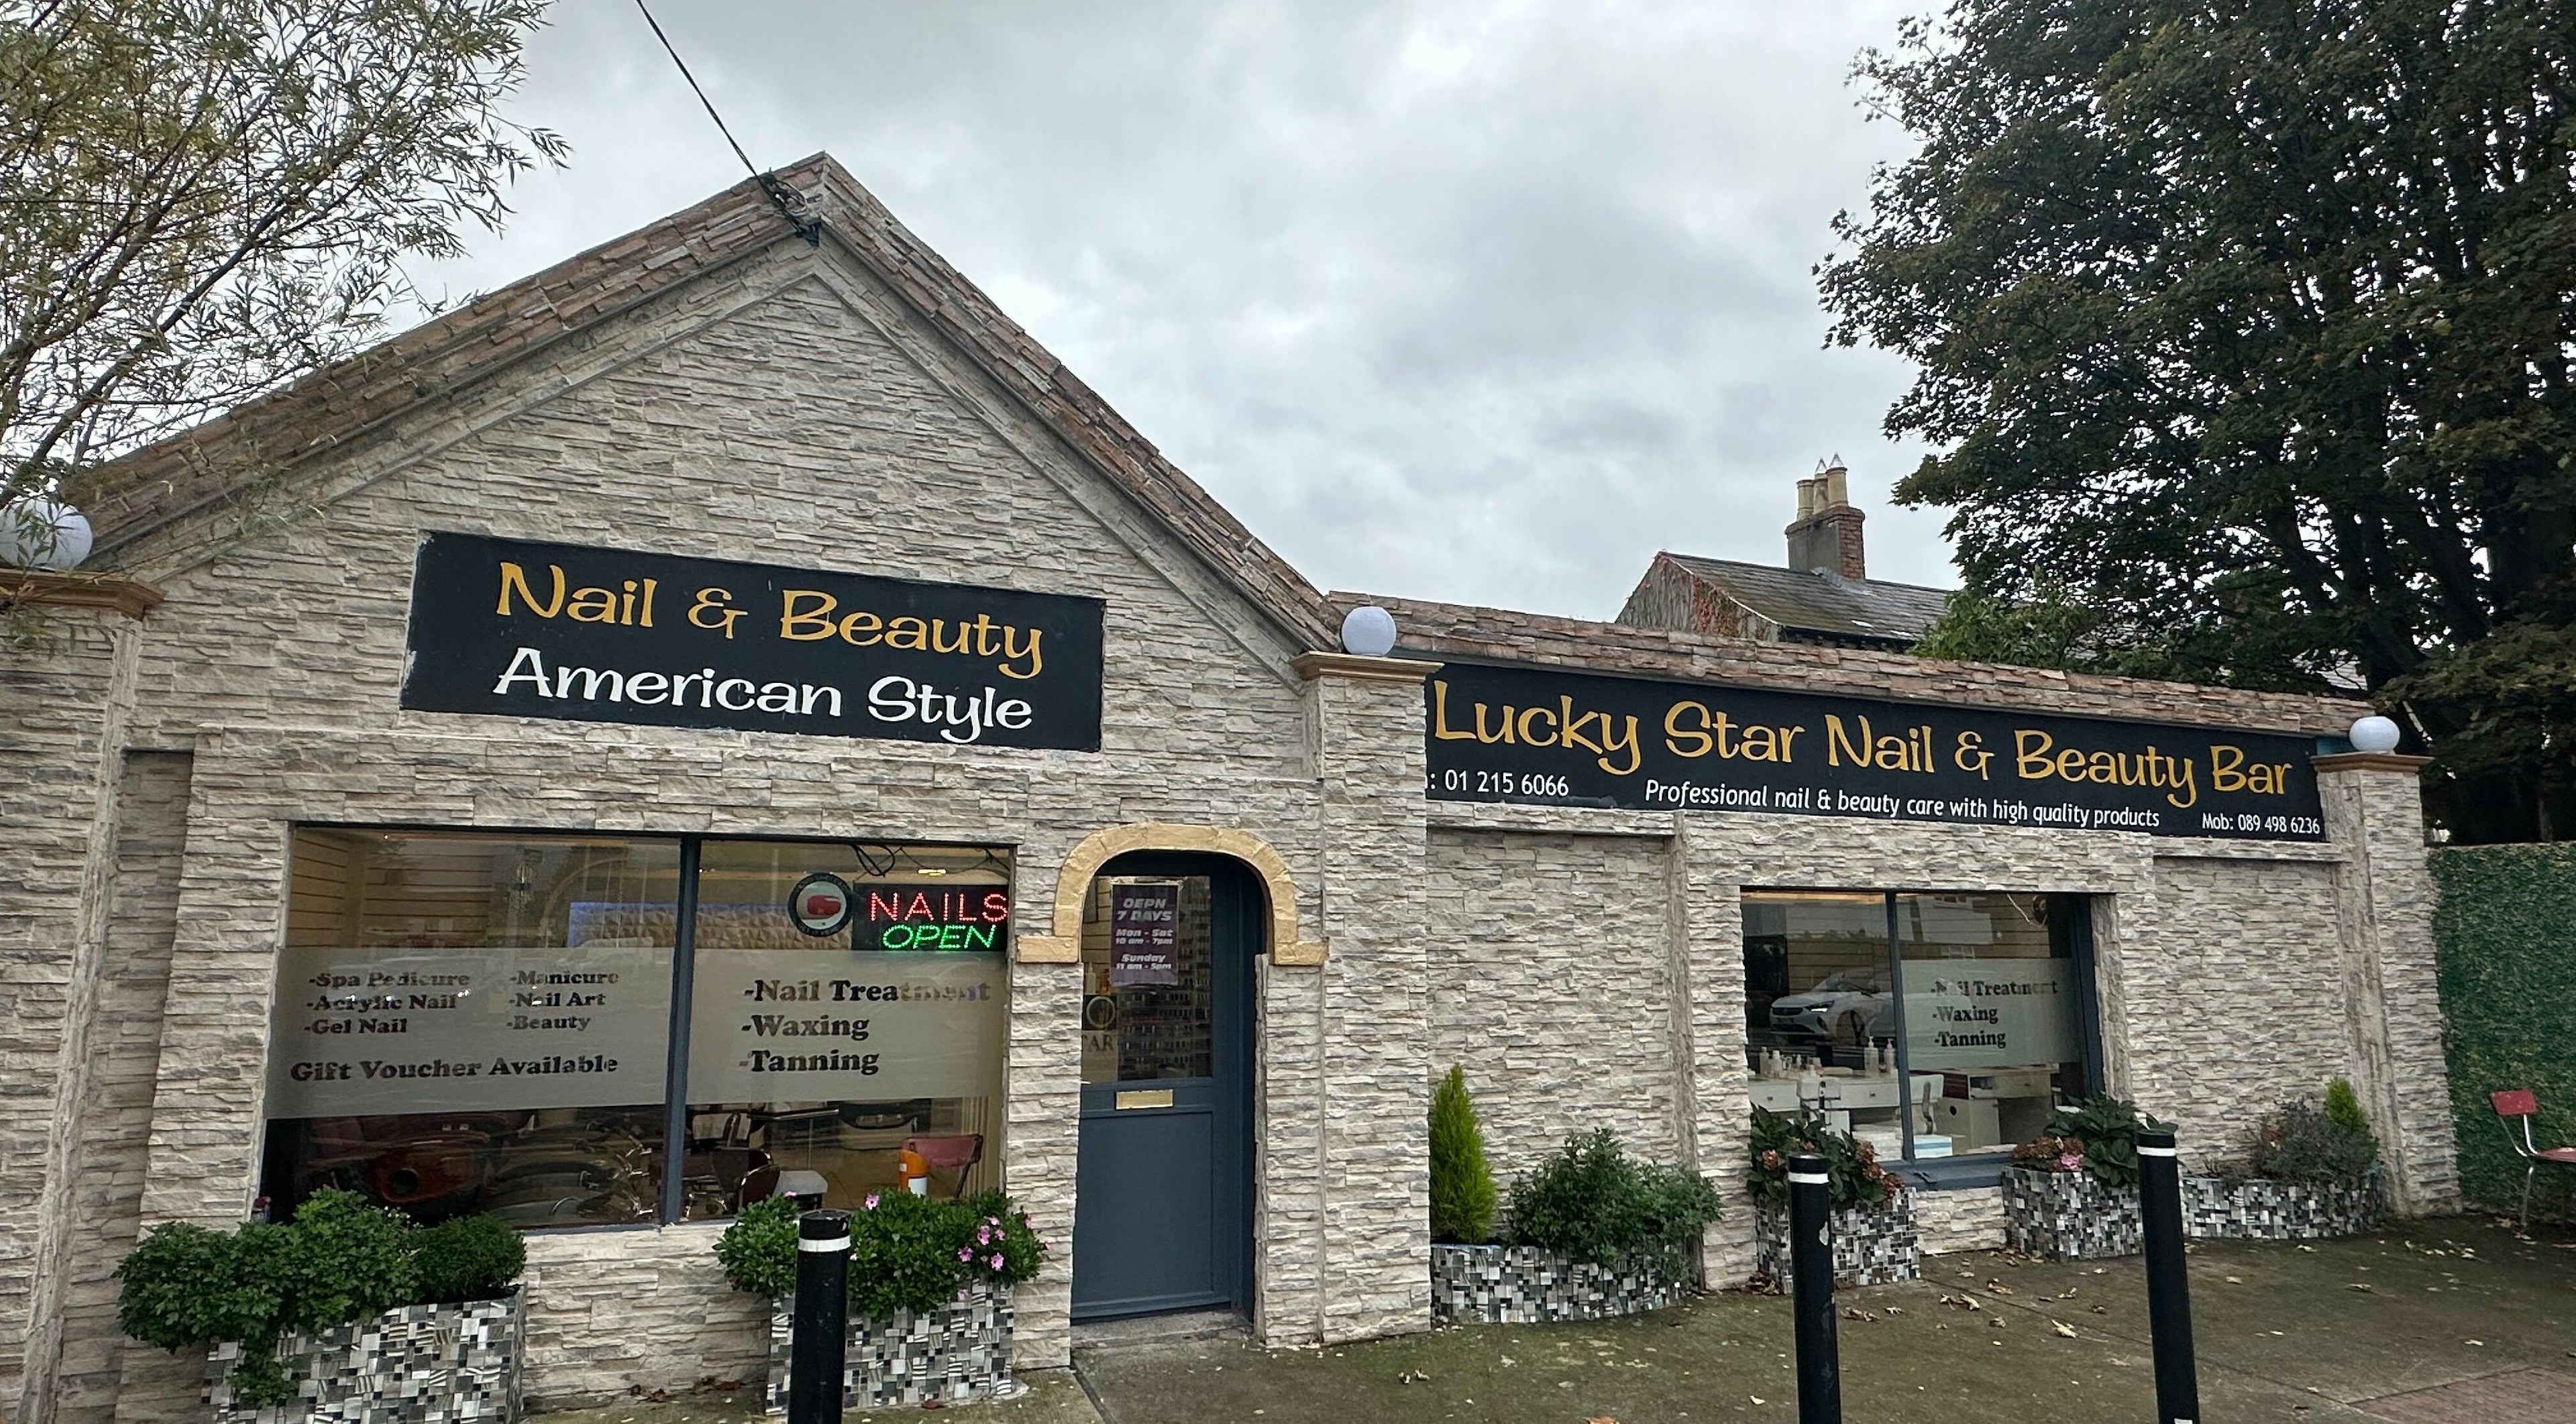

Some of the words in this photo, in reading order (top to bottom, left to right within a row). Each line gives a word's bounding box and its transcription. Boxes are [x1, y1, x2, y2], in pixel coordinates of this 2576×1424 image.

[497, 563, 657, 626] Nail
[688, 588, 748, 639] &
[780, 589, 1044, 679] Beauty
[492, 647, 841, 716] American
[867, 675, 1032, 743] Style
[1431, 680, 1640, 775] Lucky
[1665, 702, 1805, 762] Star
[1825, 715, 1934, 773] Nail
[1955, 732, 1994, 780] &
[2014, 729, 2196, 809] Beauty
[2210, 746, 2292, 794] Bar
[1446, 769, 1466, 790] 01
[1478, 771, 1513, 793] 215
[1521, 774, 1568, 796] 6066
[1645, 779, 1767, 807] Professional
[1775, 787, 1809, 808] nail
[1818, 789, 1831, 810] &
[1837, 790, 1900, 818] beauty
[1907, 800, 1944, 816] care
[1949, 798, 1987, 820] with
[1992, 799, 2028, 825] high
[2033, 802, 2090, 826] quality
[2094, 808, 2160, 829] products
[2202, 813, 2233, 830] Mob:
[2238, 814, 2260, 831] 089
[2265, 816, 2287, 832] 498
[2291, 817, 2320, 834] 6236
[869, 891, 1009, 922] NAILS
[1123, 897, 1167, 909] OEPN
[1117, 910, 1127, 921] 7
[1130, 910, 1173, 922] DAYS
[882, 924, 996, 950] OPEN
[1122, 954, 1166, 963] Sunday
[367, 972, 470, 987] Pedicure
[566, 992, 606, 1006] Art
[828, 980, 991, 1001] Treatment
[409, 994, 457, 1009] Nail
[358, 1018, 408, 1034] Nail
[1082, 1034, 1114, 1053] AR
[290, 1061, 352, 1081] Gift
[359, 1059, 483, 1079] Voucher
[488, 1054, 619, 1076] Available
